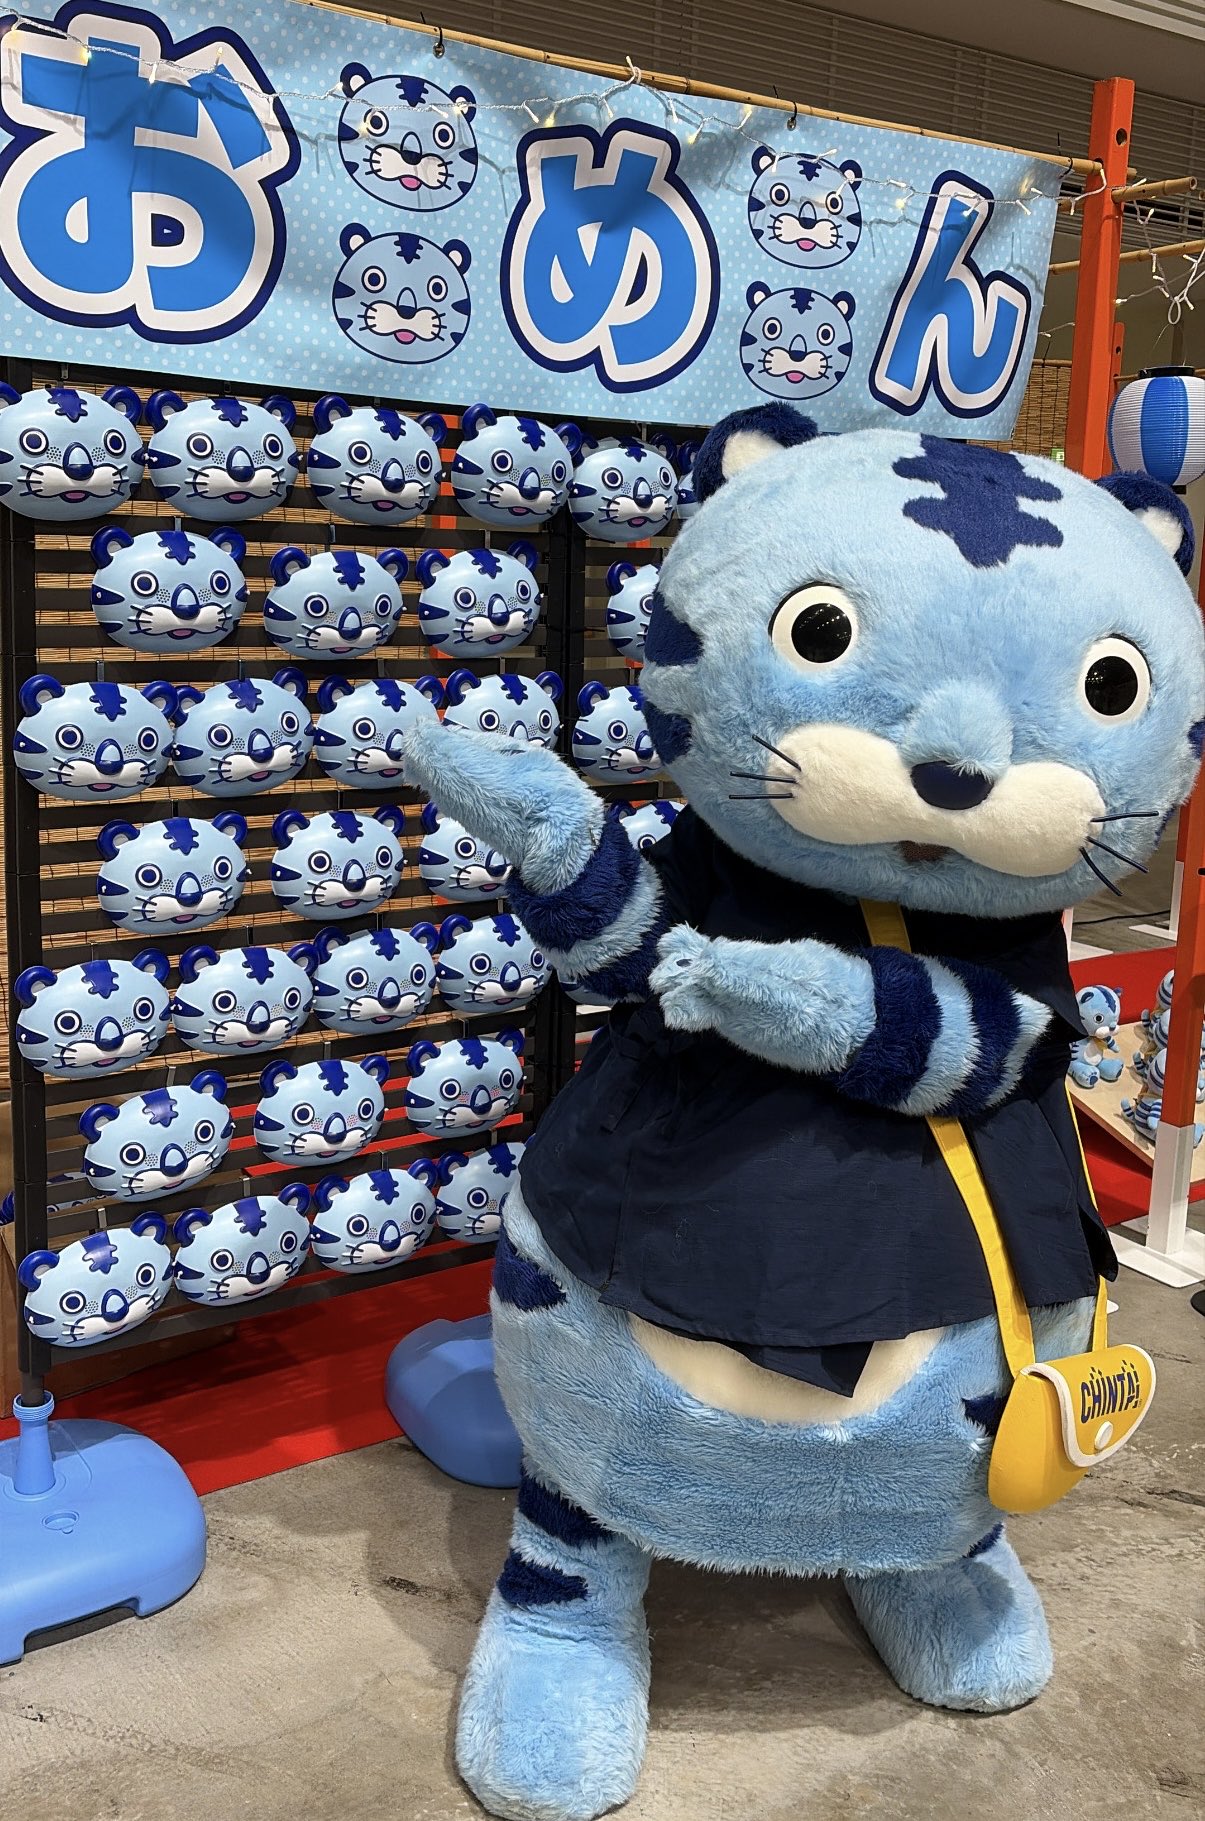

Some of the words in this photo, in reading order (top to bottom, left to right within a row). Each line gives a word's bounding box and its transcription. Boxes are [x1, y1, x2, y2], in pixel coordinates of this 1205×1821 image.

[0, 4, 1030, 416] おめん
[1080, 1361, 1140, 1424] CHINTAI
